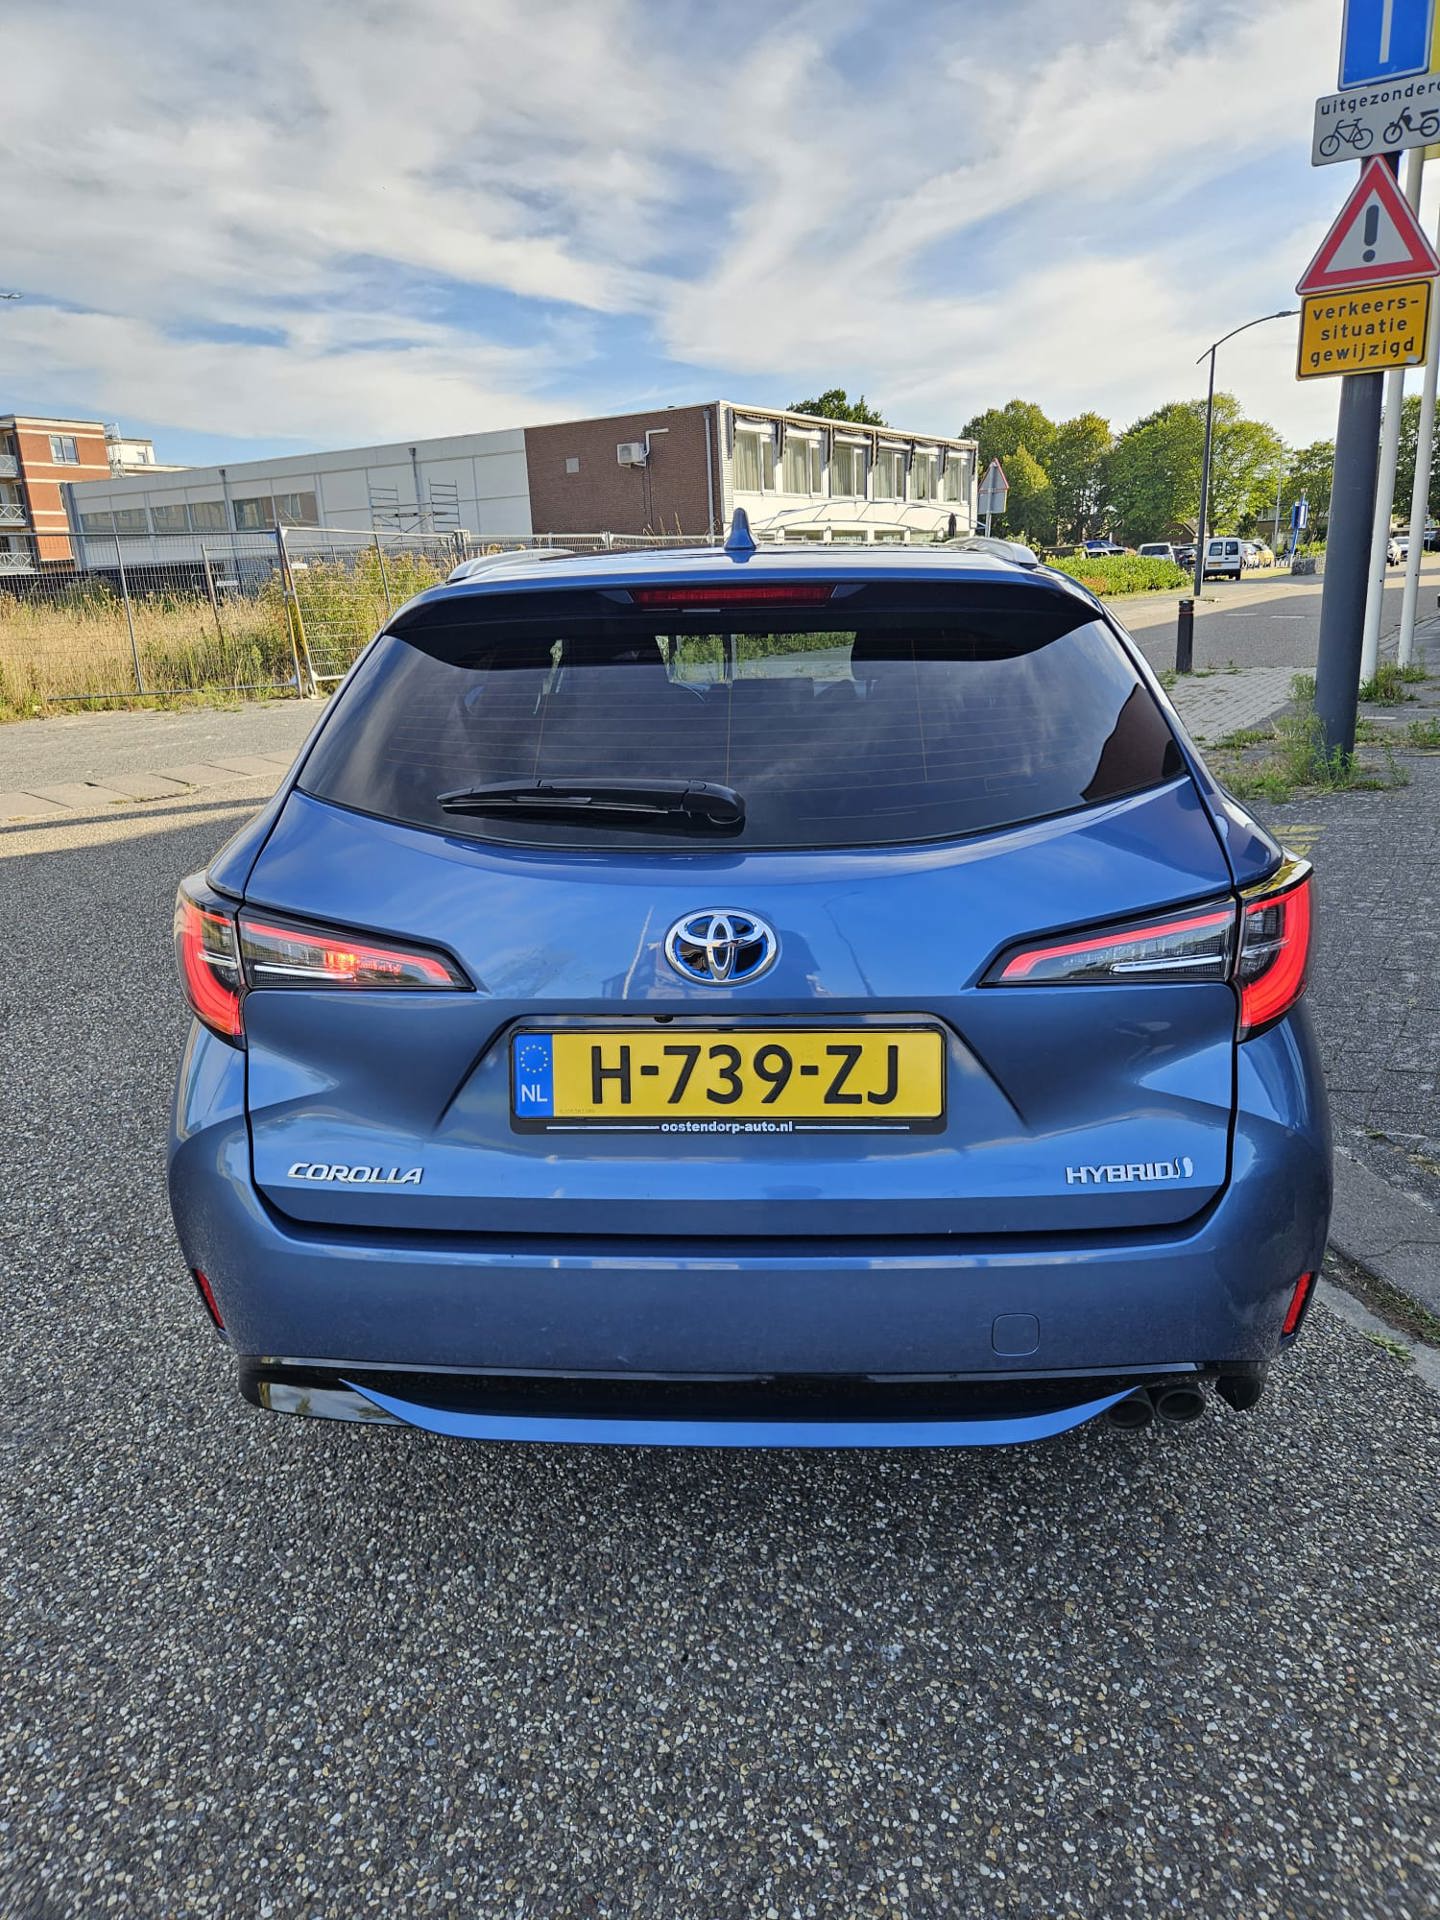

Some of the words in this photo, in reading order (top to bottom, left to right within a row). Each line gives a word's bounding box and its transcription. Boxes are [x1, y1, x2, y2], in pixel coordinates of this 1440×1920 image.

[1313, 298, 1419, 320] verkeers-
[1321, 318, 1407, 340] situatie
[1310, 337, 1414, 367] gewijzigd
[591, 1044, 899, 1105] H-739-ZJ
[521, 1084, 548, 1102] NL
[661, 1121, 793, 1134] oostendorp-auto.nl
[287, 1162, 423, 1184] COROLLA
[1066, 1160, 1181, 1184] HYBRID
